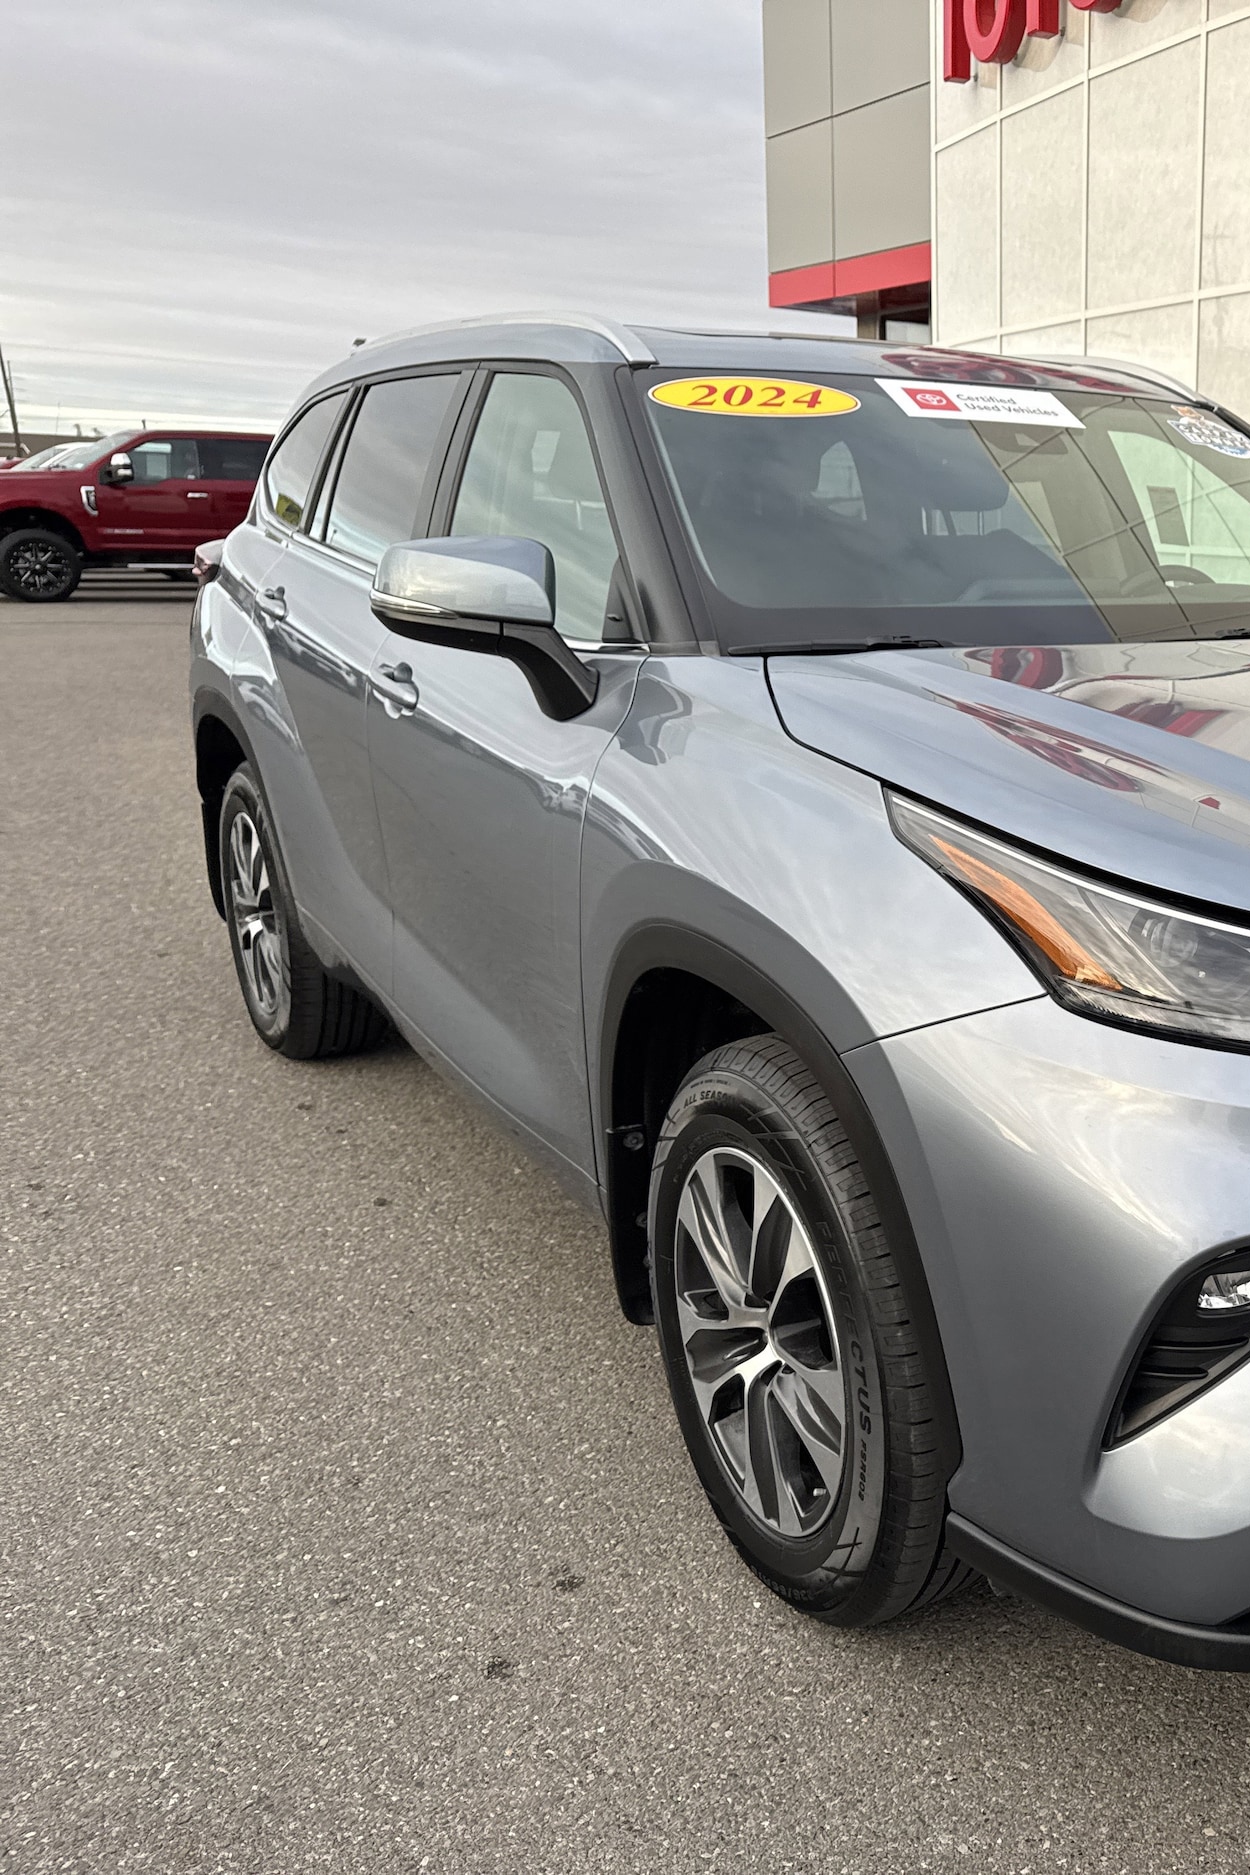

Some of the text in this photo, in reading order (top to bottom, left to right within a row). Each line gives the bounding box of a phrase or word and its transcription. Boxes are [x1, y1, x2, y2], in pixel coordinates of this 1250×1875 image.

[686, 384, 823, 409] 2024
[955, 393, 1018, 406] Certified
[963, 402, 1059, 417] Used Vehicles
[683, 1093, 698, 1109] ALL
